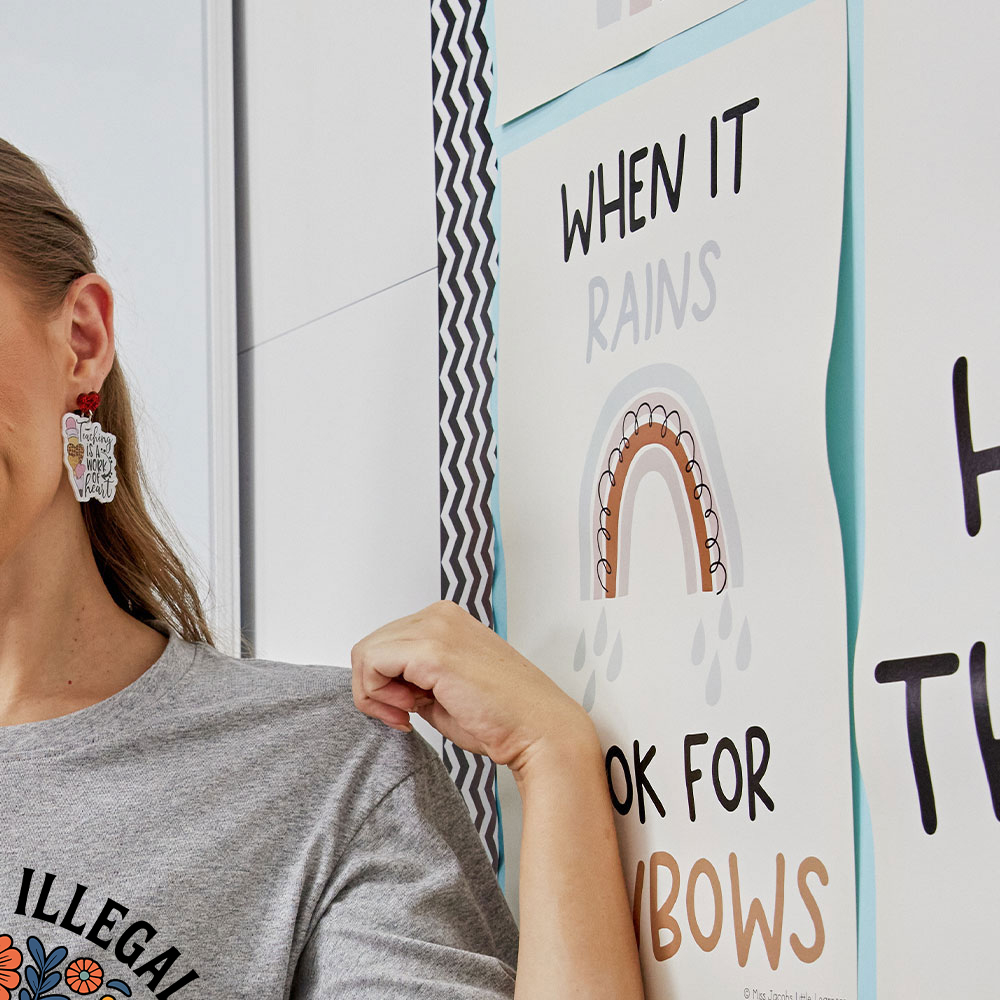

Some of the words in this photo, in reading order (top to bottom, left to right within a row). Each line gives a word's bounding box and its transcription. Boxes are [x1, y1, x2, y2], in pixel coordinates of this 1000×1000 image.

[561, 134, 686, 263] WHEN
[710, 97, 760, 198] IT
[585, 240, 721, 364] RAINS
[76, 419, 113, 453] Teaching
[86, 458, 107, 472] WORK
[92, 472, 101, 485] OF
[85, 474, 115, 498] heart
[605, 739, 666, 825] OK
[684, 726, 775, 822] FOR
[633, 851, 829, 971] BOWS
[752, 988, 766, 1000] Miss
